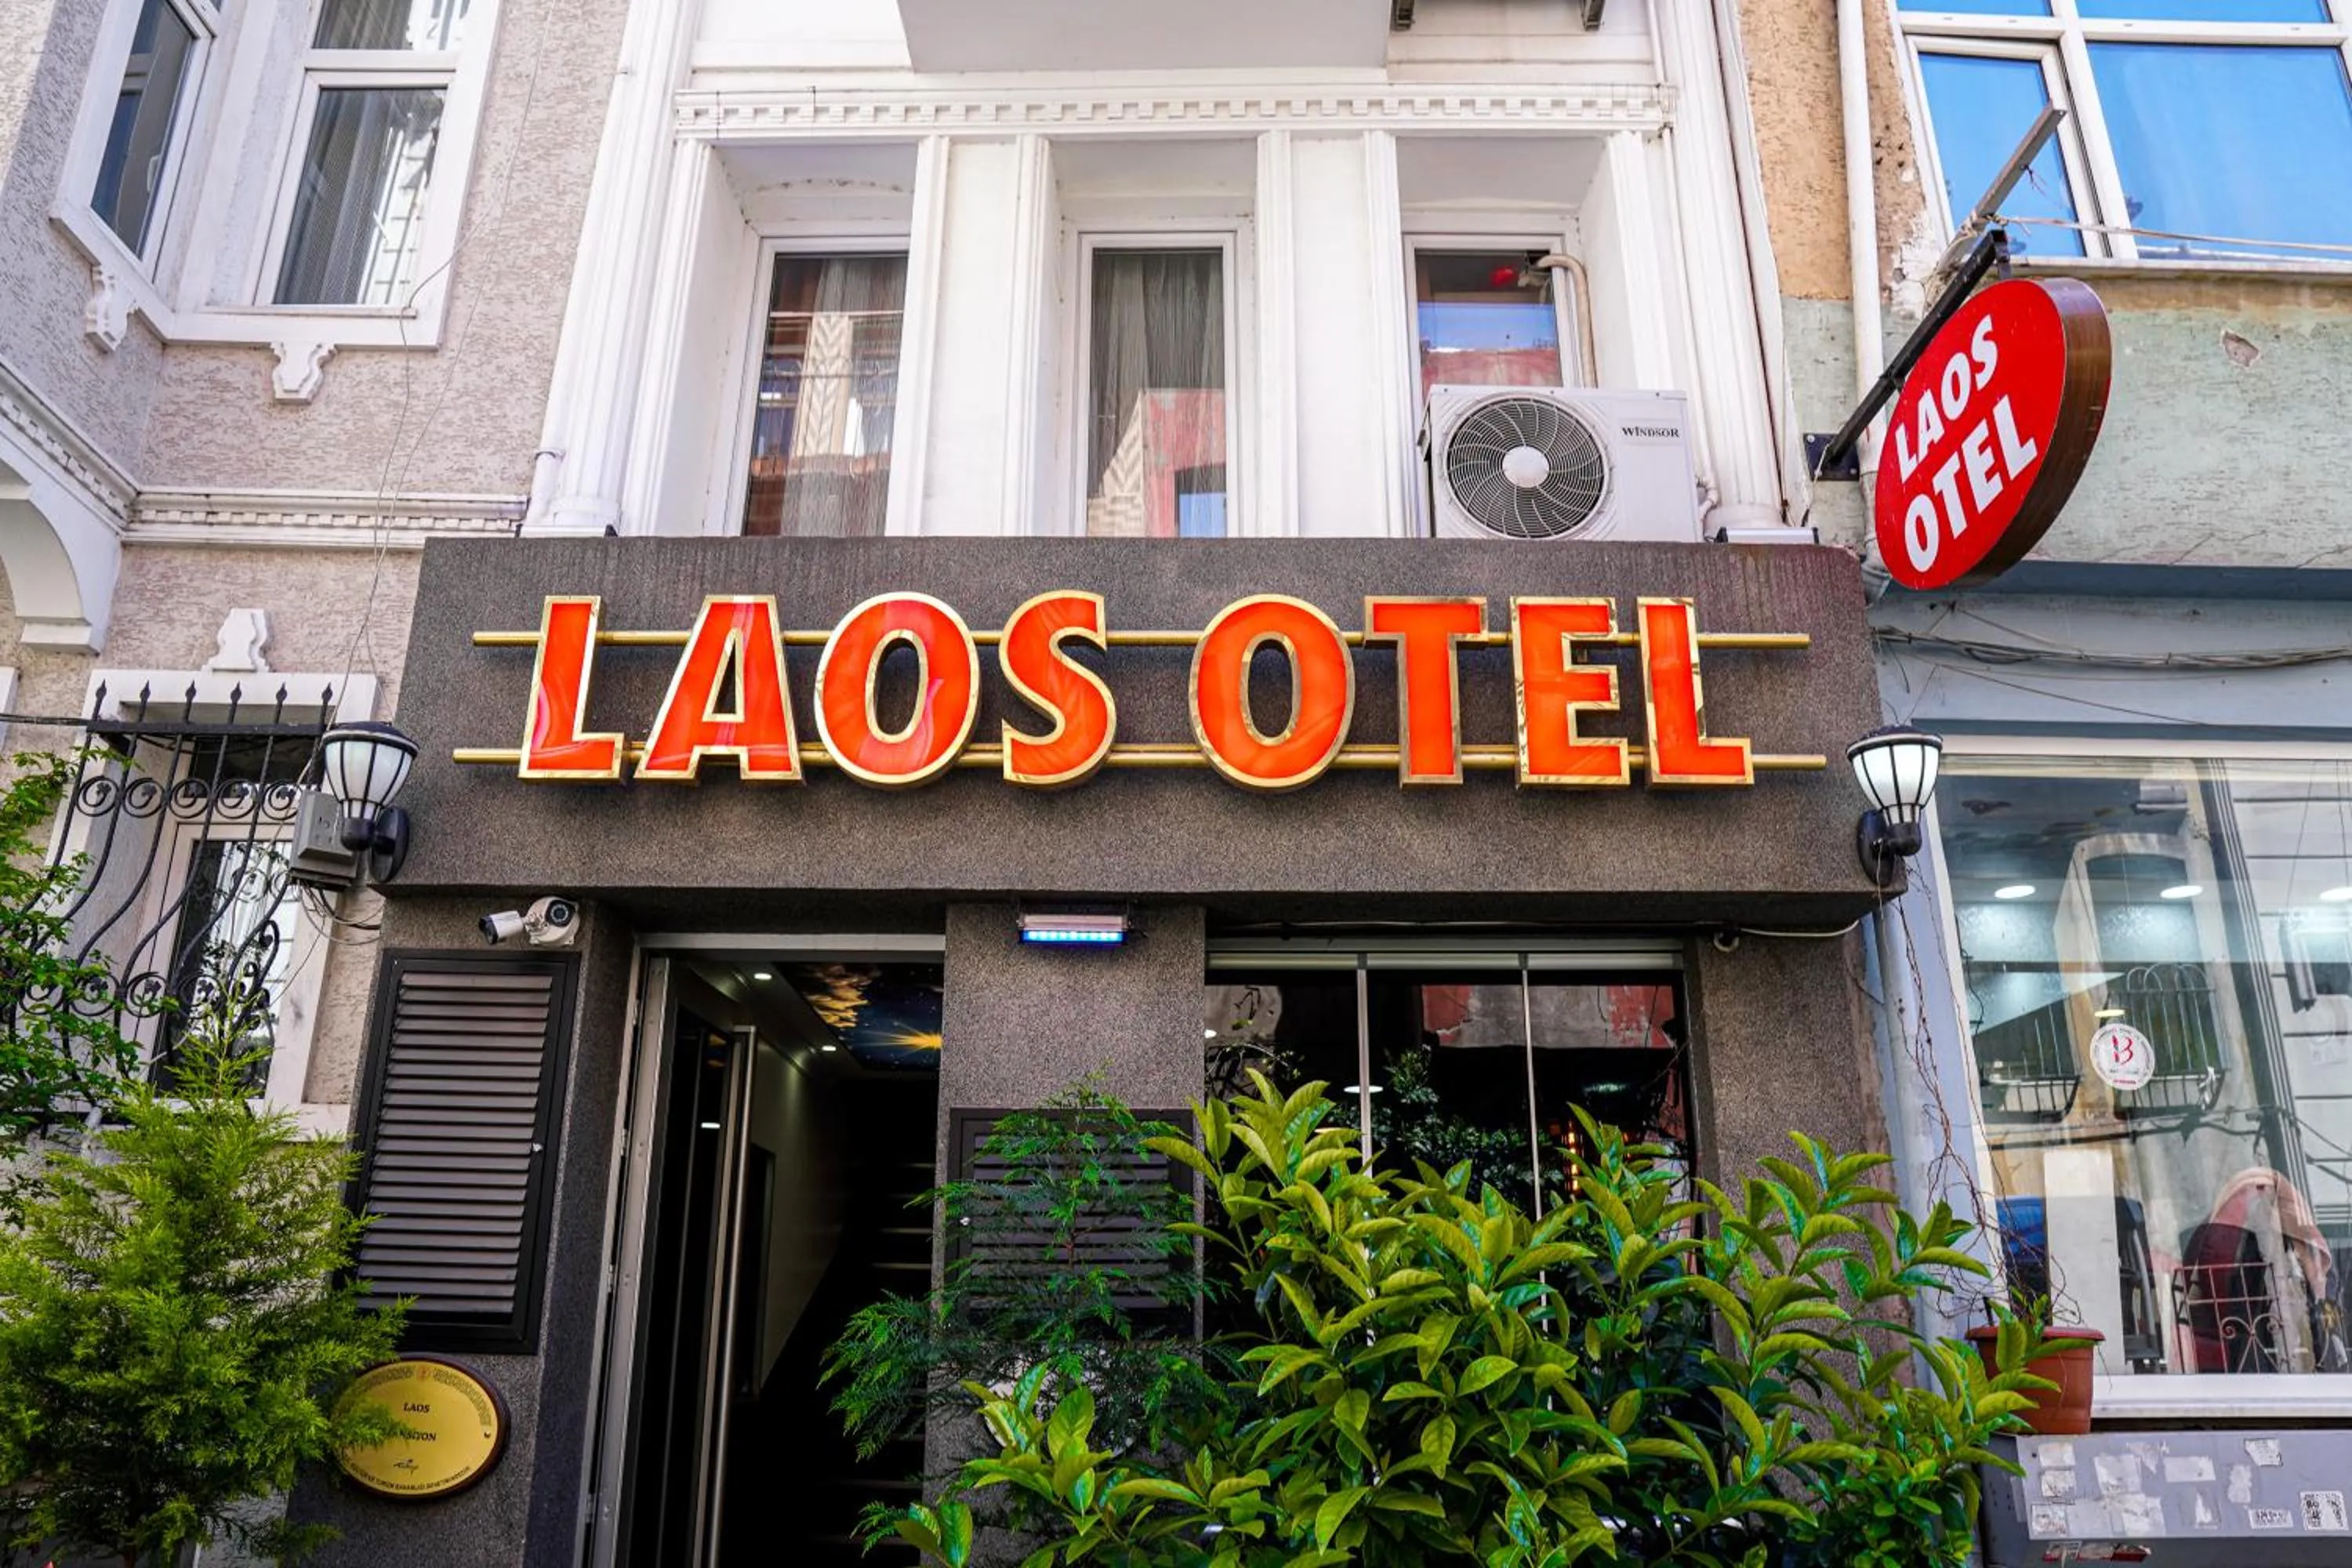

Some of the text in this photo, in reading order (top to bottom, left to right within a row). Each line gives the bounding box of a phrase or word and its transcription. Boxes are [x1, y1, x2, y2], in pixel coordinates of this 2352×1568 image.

[1621, 426, 1680, 438] WINDSOR
[1894, 314, 1998, 484] LAOS
[1904, 394, 2038, 573] OTEL
[517, 590, 1755, 788] LAOS OTEL
[403, 1402, 430, 1414] LAOS
